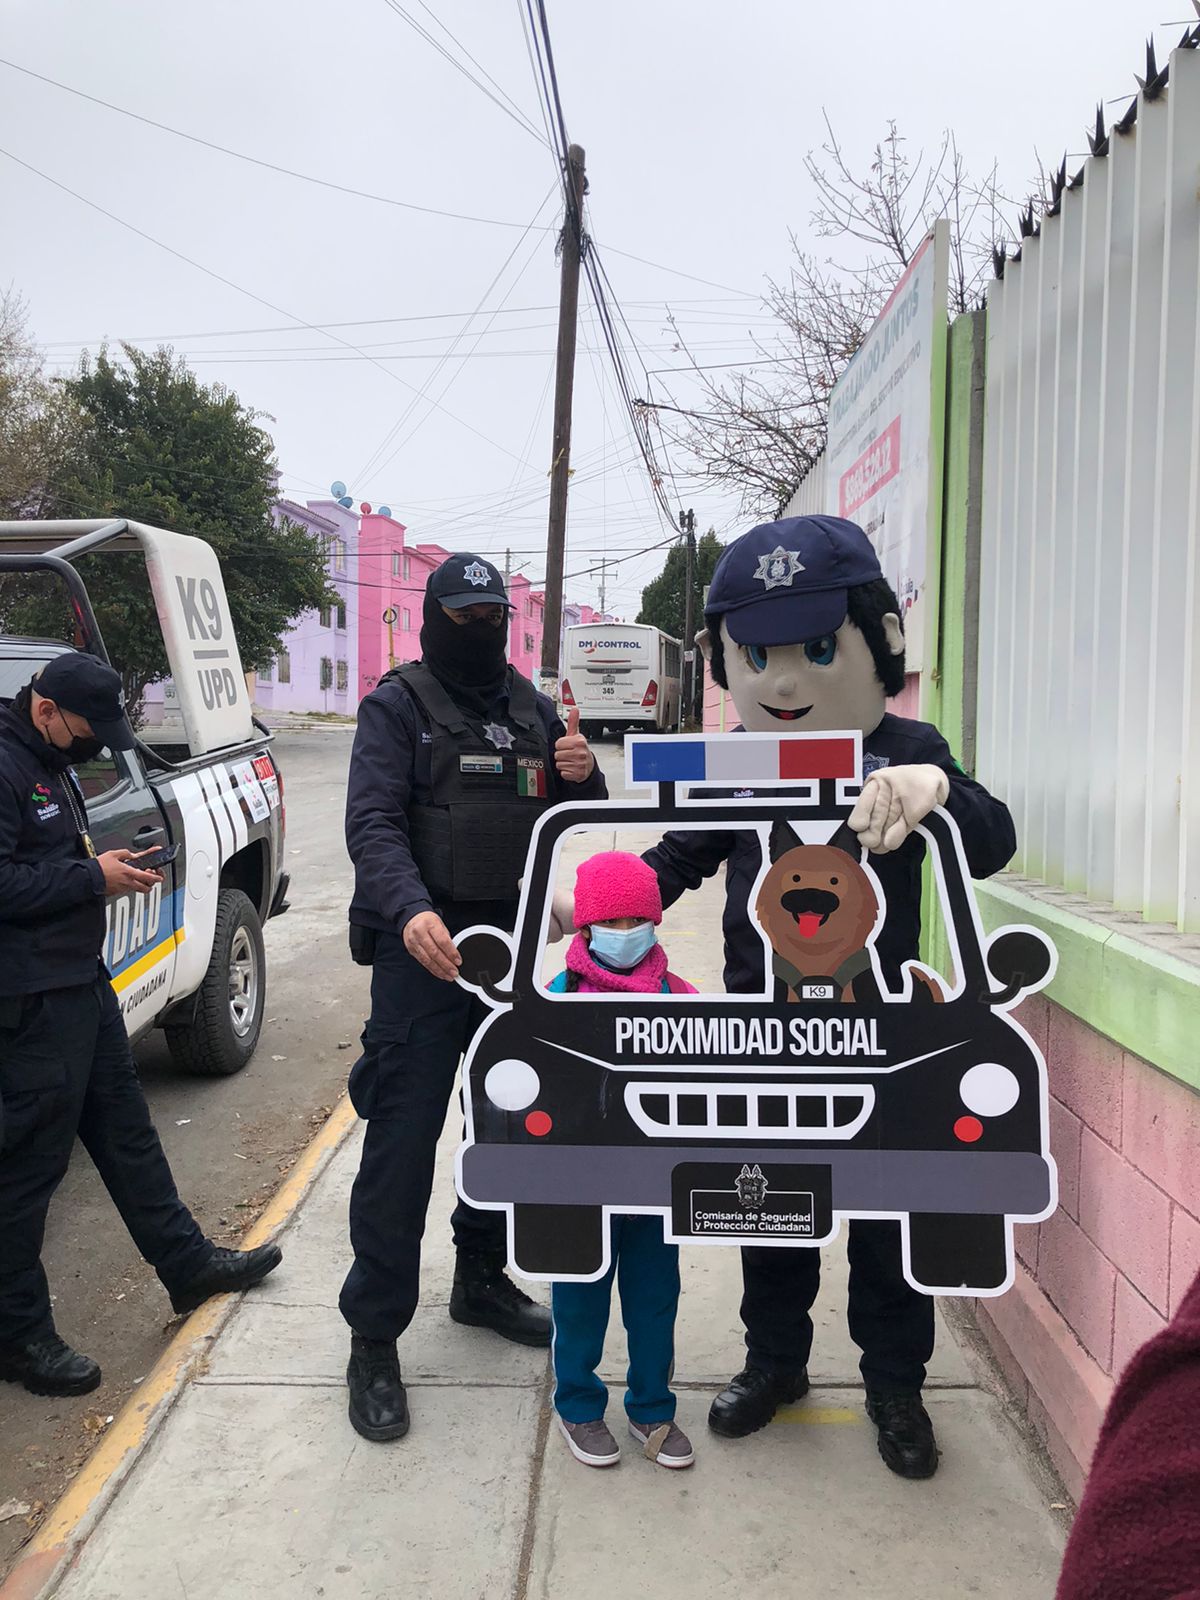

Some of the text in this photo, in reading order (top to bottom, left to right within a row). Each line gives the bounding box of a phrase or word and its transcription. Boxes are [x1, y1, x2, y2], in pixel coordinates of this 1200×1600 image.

[175, 575, 222, 641] K9
[597, 641, 642, 649] CONTROL
[197, 668, 237, 711] UPD
[602, 687, 615, 695] 345
[517, 757, 544, 769] MEXICO
[127, 968, 167, 1014] CIUDADANA
[809, 986, 827, 997] K9
[615, 1017, 887, 1056] PROXIMIDAD SOCIAL
[695, 1210, 811, 1223] Comisaría de Seguridad
[695, 1220, 811, 1232] y Protección Ciudadana
